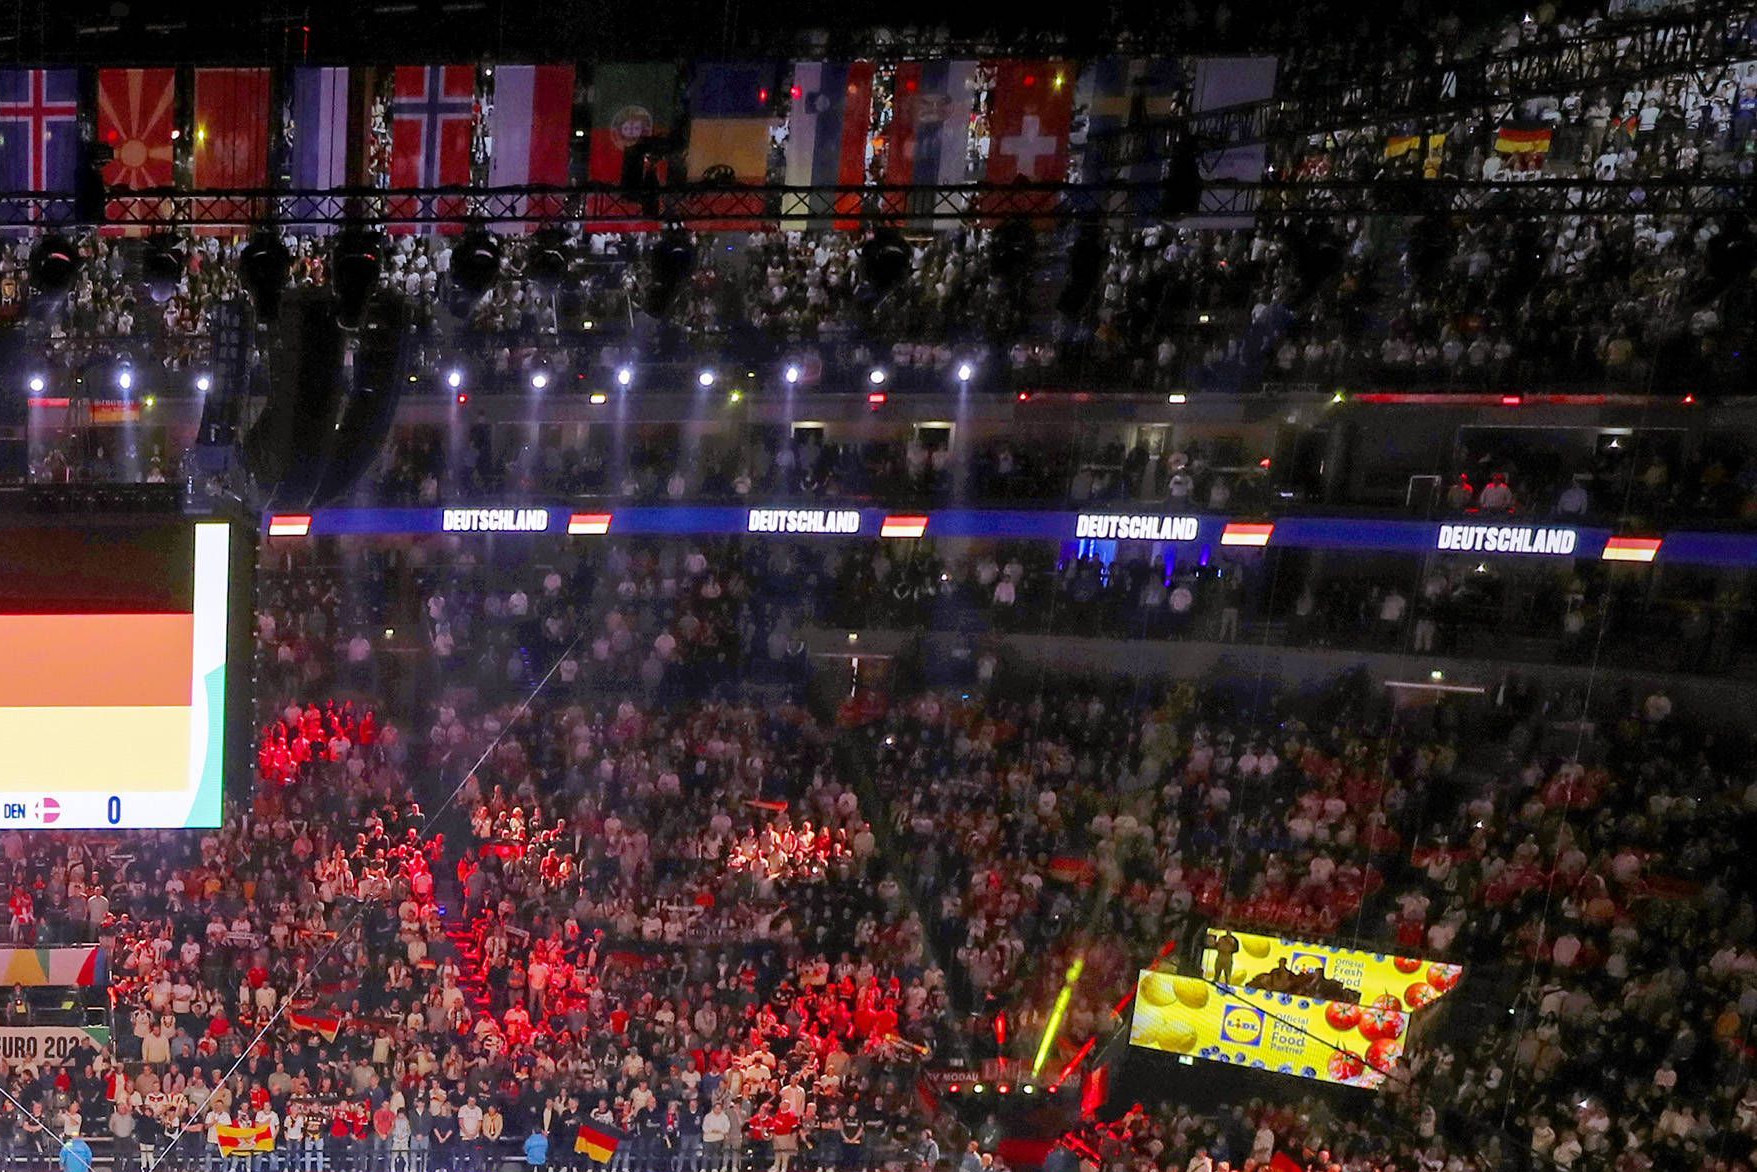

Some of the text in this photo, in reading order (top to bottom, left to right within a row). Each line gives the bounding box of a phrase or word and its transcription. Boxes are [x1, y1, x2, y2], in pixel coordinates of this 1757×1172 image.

[443, 509, 547, 532] DEUTSCHLAND
[748, 509, 860, 533] DEUTSCHLAND
[1076, 514, 1199, 540] DEUTSCHLAND
[1437, 525, 1576, 554] DEUTSCHLAND
[4, 796, 121, 825] DEN 0
[1274, 1021, 1308, 1036] Fresh
[1275, 1012, 1309, 1025] Official
[44, 1036, 80, 1059] 202
[1270, 1043, 1305, 1056] Partner
[1271, 1033, 1305, 1048] Food
